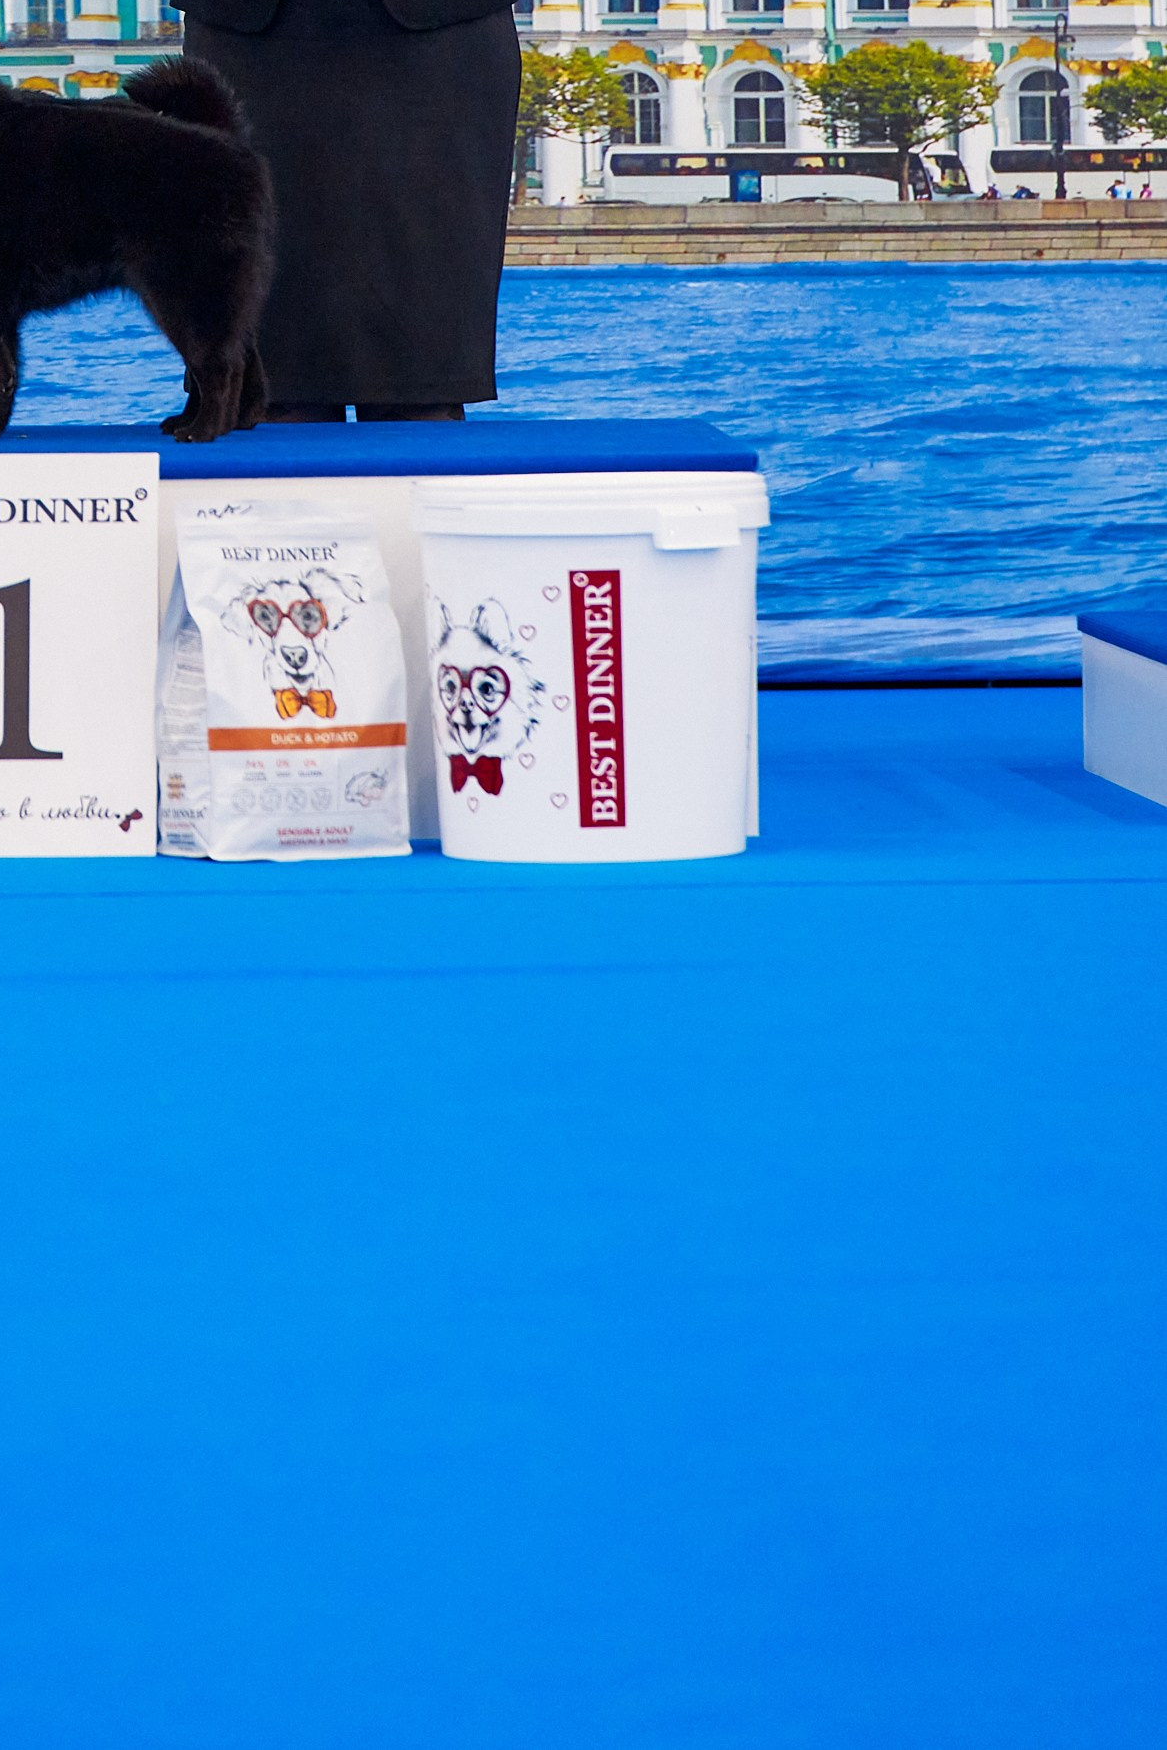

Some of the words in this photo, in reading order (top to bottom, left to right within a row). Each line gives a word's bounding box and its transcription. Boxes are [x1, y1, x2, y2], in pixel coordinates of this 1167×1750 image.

[221, 548, 261, 561] BEST
[267, 547, 335, 561] DINNER
[584, 580, 615, 724] DINNER
[270, 733, 302, 745] DUCK
[314, 731, 359, 743] POTATO
[589, 731, 619, 823] BEST
[19, 797, 33, 820] в
